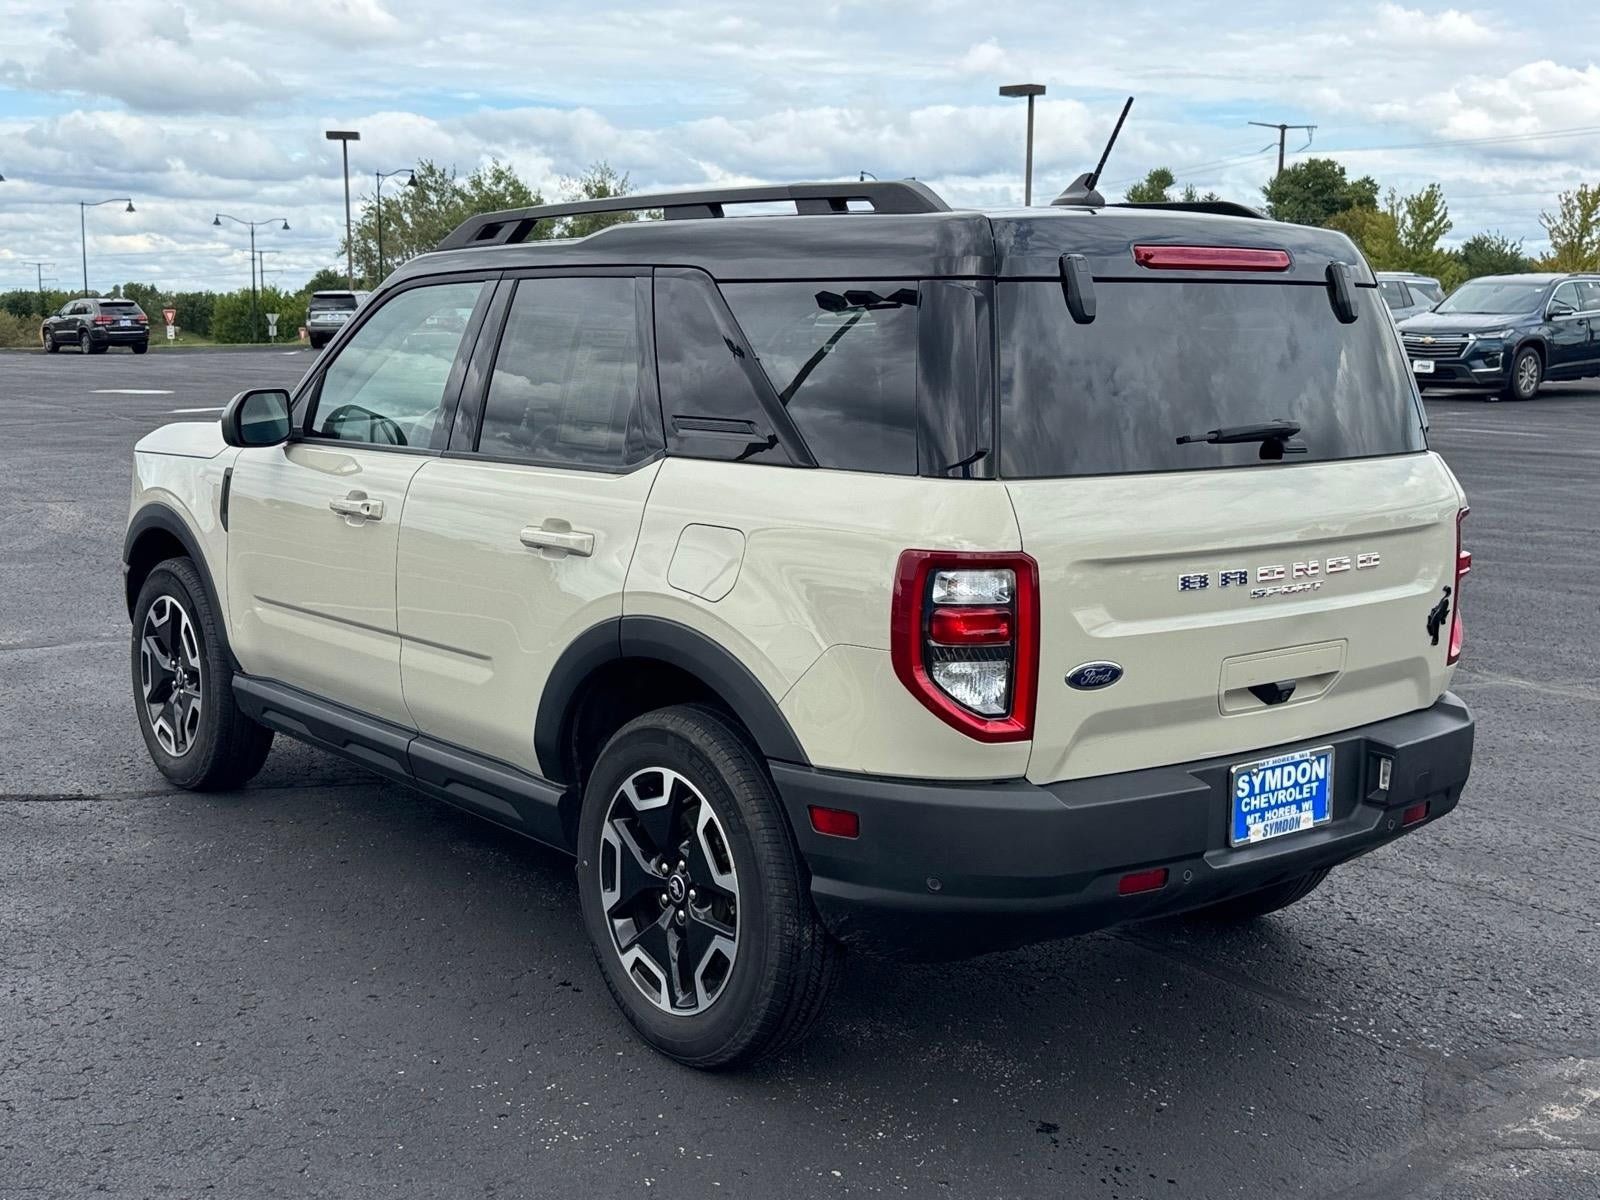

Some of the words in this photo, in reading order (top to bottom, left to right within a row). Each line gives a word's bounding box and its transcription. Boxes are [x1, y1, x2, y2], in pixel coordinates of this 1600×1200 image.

[1178, 552, 1380, 591] BRONCO
[1250, 580, 1325, 599] SPORT
[1081, 667, 1112, 685] Ford
[1236, 758, 1326, 798] SYMDON
[1241, 782, 1319, 812] CHEVROLET
[1246, 813, 1262, 825] MT.
[1265, 805, 1299, 821] HOREB,
[1301, 800, 1313, 812] WI
[1262, 816, 1301, 838] SYMDON
